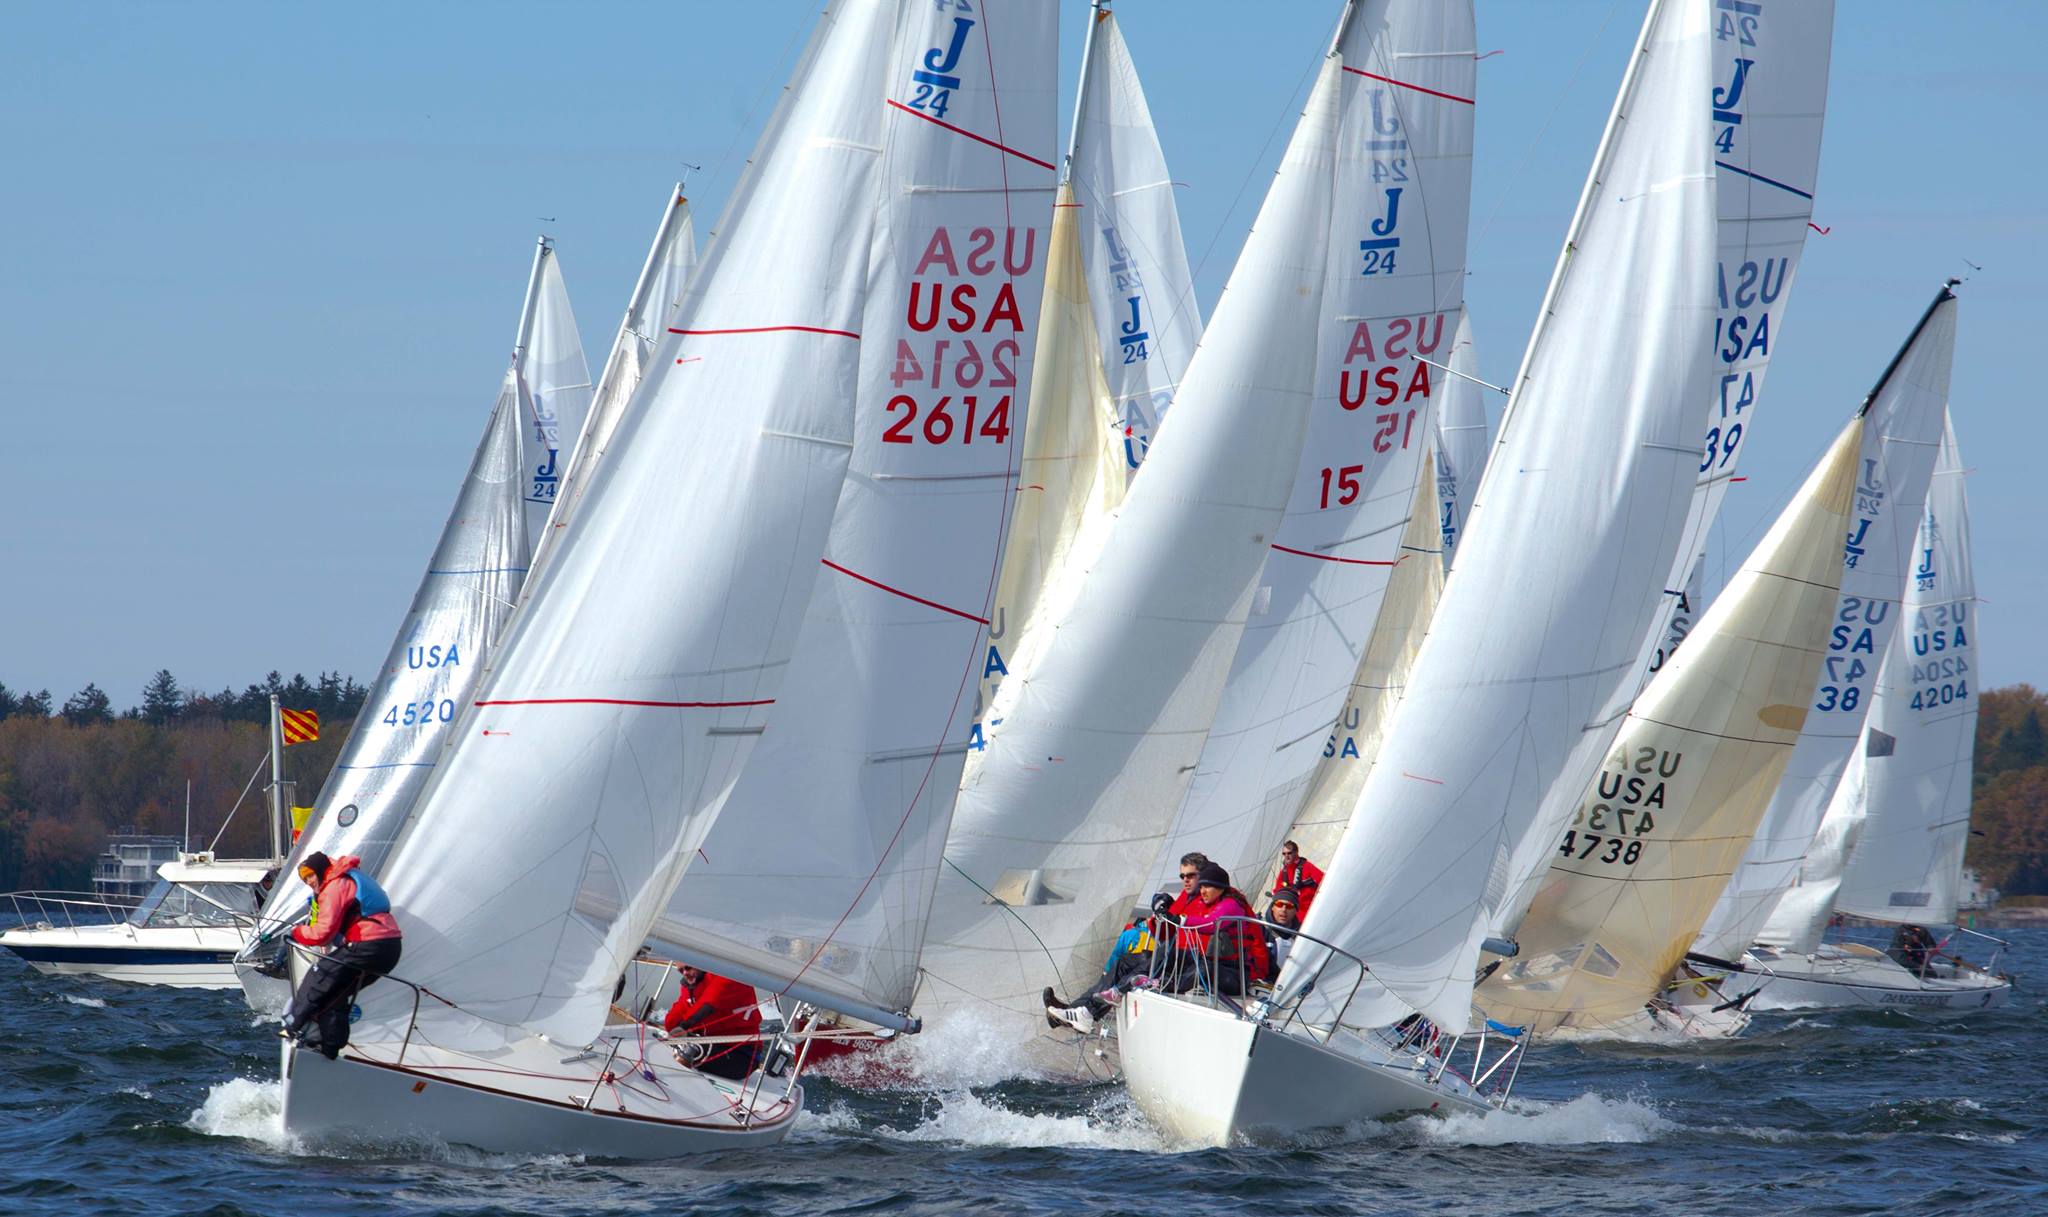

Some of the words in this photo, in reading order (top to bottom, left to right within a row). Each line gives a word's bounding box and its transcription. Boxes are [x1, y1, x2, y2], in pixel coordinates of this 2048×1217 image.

[923, 17, 975, 73] J
[1713, 58, 1755, 109] J
[907, 84, 950, 118] 24
[1713, 126, 1734, 153] 4
[1371, 188, 1403, 236] J
[1361, 250, 1396, 275] 24
[907, 282, 1024, 333] USA
[1121, 296, 1141, 335] J
[1123, 341, 1148, 364] 24
[1339, 360, 1430, 411] USA
[882, 394, 1011, 444] 2614
[537, 449, 558, 476] J
[1699, 423, 1742, 473] 39
[533, 484, 555, 497] 24
[1320, 464, 1363, 509] 15
[1847, 518, 1872, 546] J
[1919, 549, 1934, 573] J
[1918, 579, 1935, 592] 24
[1829, 625, 1873, 654] SA
[1914, 625, 1967, 656] USA
[408, 644, 460, 669] USA
[1816, 686, 1860, 712] 38
[1910, 680, 1968, 711] 4204
[383, 699, 455, 727] 4520
[1598, 771, 1665, 809] USA
[1559, 830, 1642, 865] 4738
